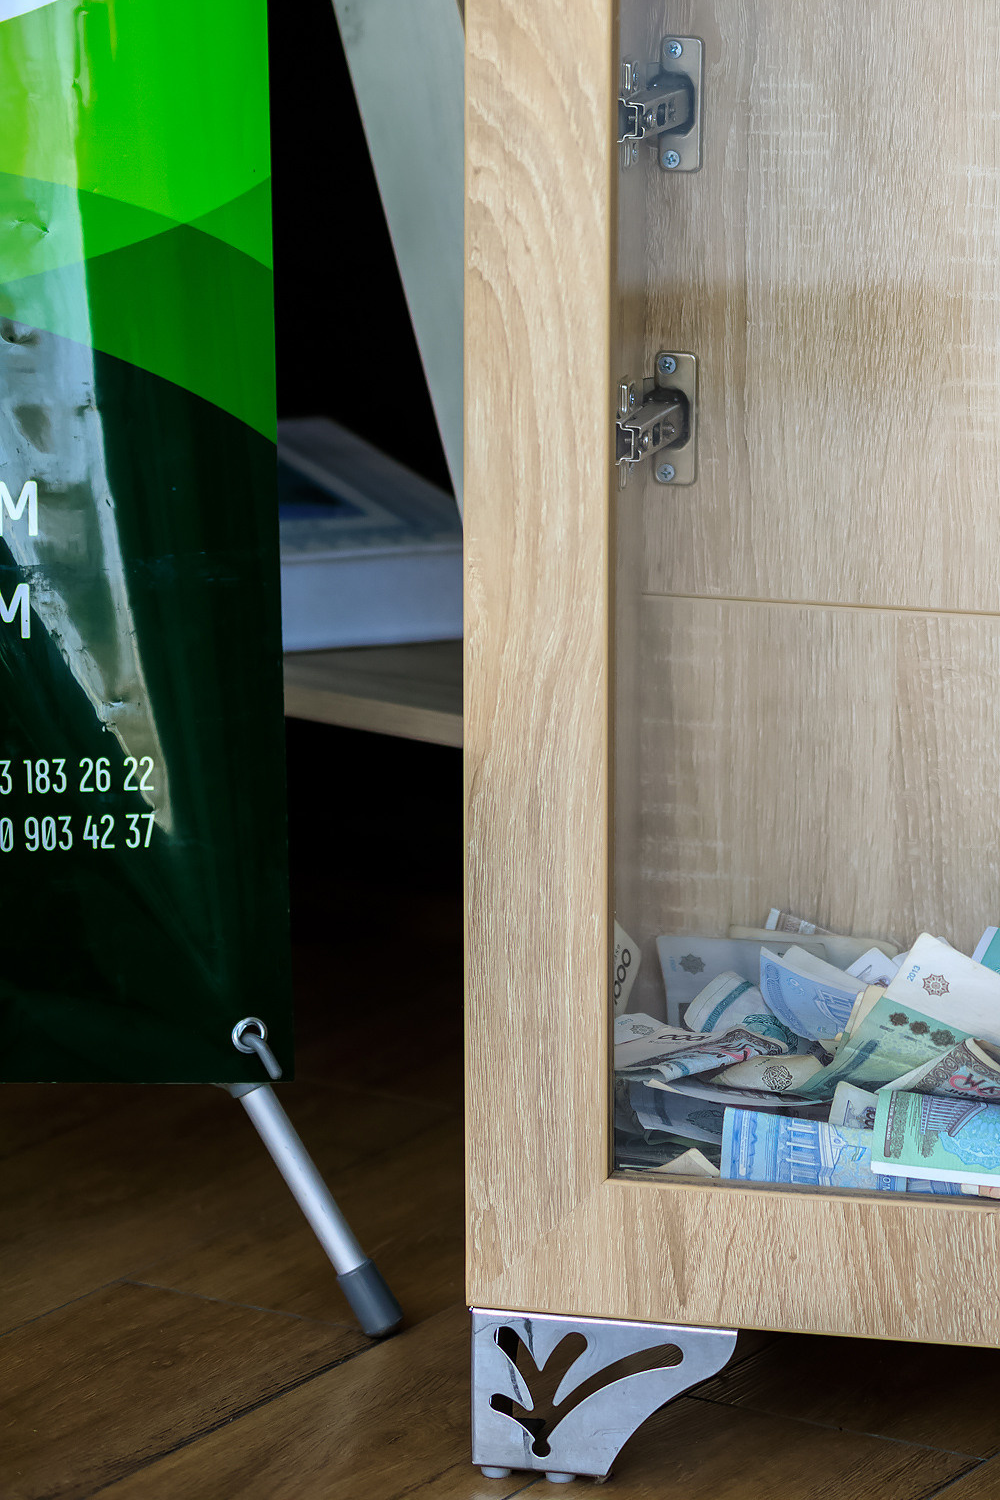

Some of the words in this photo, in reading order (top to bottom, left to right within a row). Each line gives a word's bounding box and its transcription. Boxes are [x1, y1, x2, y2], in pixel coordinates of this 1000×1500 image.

[23, 758, 67, 794] 183
[79, 757, 111, 793] 26
[123, 756, 155, 791] 22
[24, 815, 73, 851] 903
[83, 814, 116, 850] 42
[125, 813, 156, 849] 37
[906, 965, 921, 982] 2013
